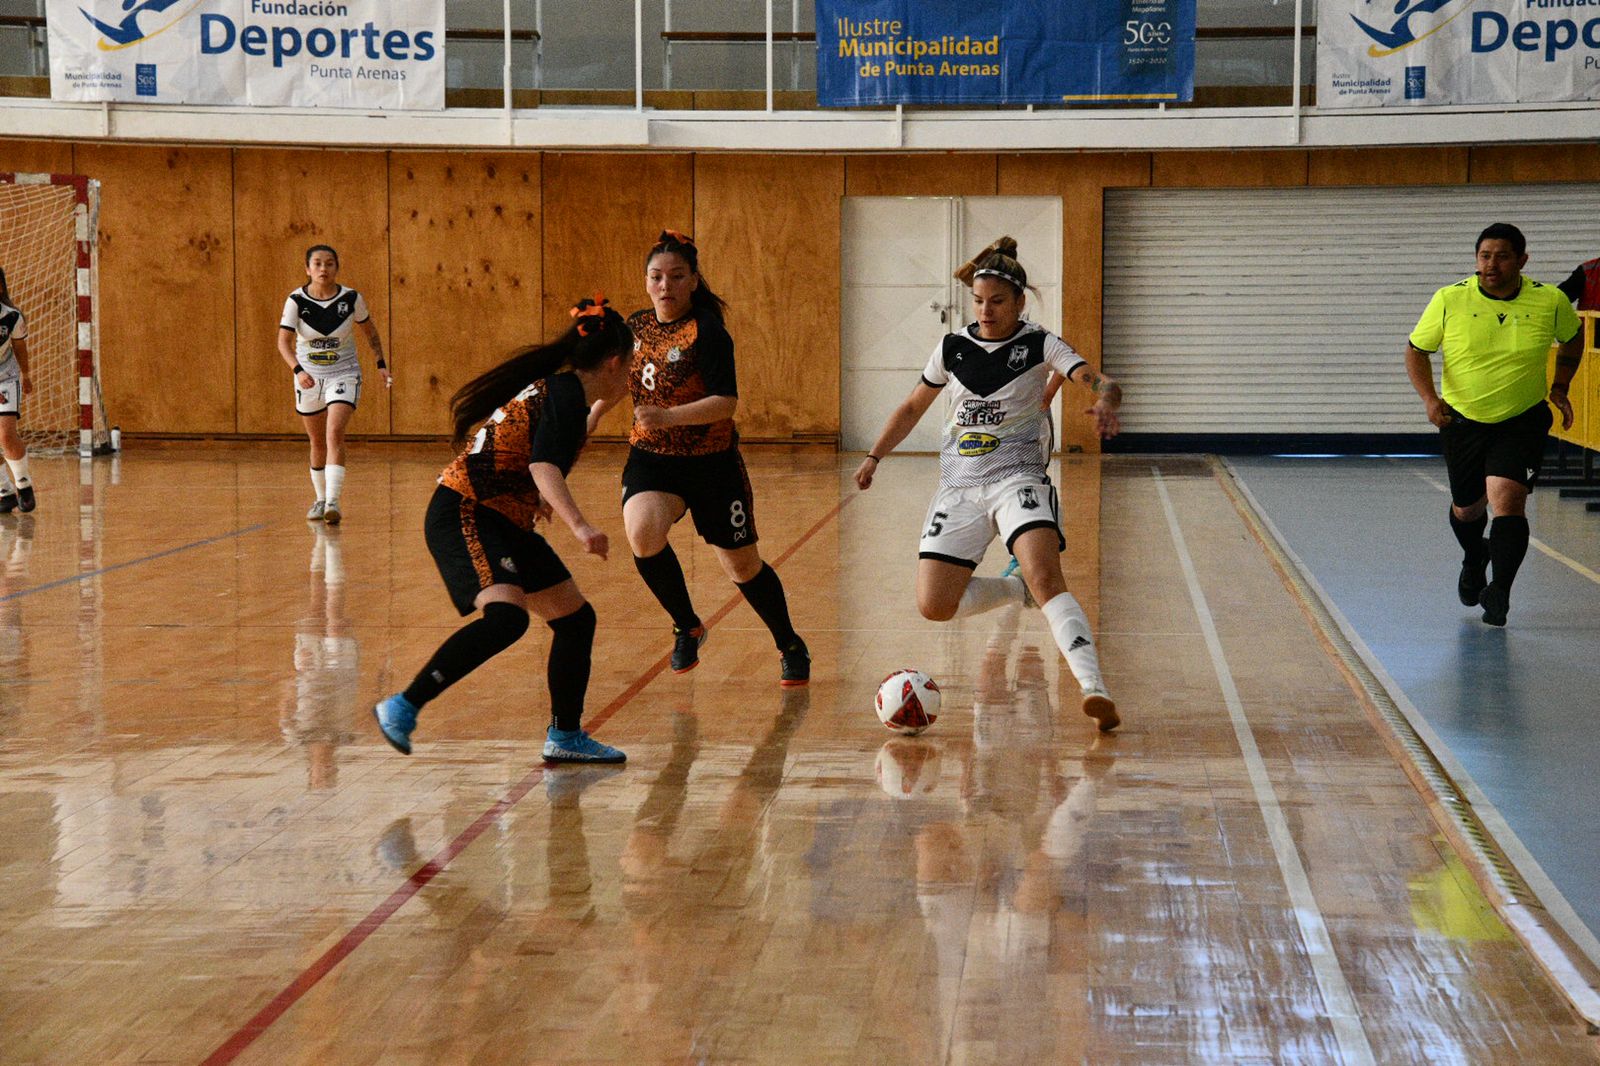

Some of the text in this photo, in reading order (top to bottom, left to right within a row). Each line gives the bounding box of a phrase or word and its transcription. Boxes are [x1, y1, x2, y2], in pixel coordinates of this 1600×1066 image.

[251, 0, 347, 16] Fundación
[838, 17, 901, 37] Ilustre
[200, 13, 436, 67] Deportes
[838, 35, 999, 60] Municipalidad
[310, 64, 406, 80] Punta Arenas
[859, 60, 1000, 77] de Punta Arenas
[1332, 78, 1391, 88] Municipalidad
[641, 362, 656, 391] 8
[730, 500, 746, 528] 8
